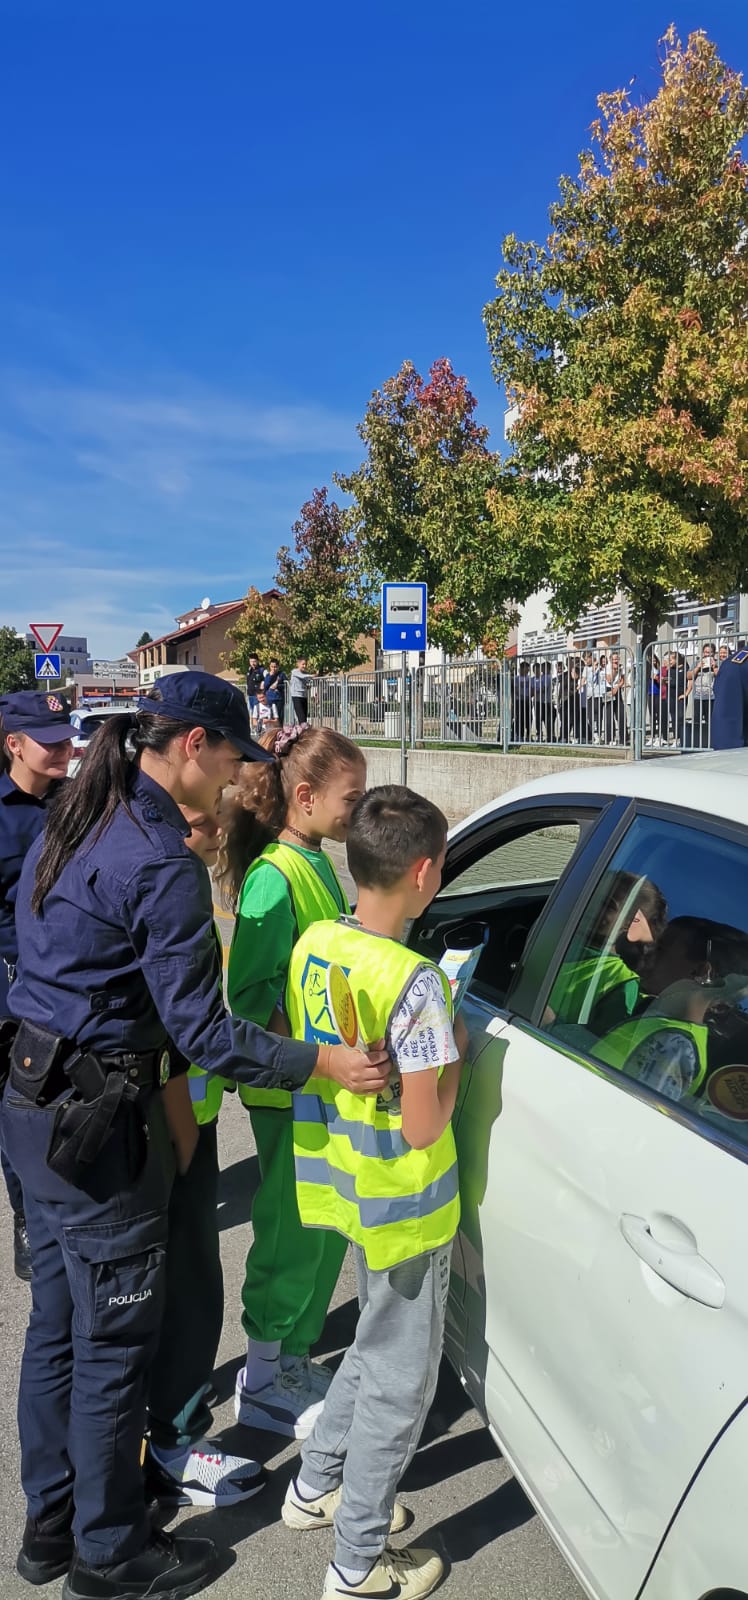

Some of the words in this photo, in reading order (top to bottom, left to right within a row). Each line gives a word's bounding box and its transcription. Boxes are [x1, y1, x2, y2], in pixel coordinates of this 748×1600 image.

[419, 1031, 427, 1044] FUN
[410, 1040, 419, 1058] FREE
[420, 1044, 430, 1063] HAVE
[108, 1288, 152, 1306] POLICIJA
